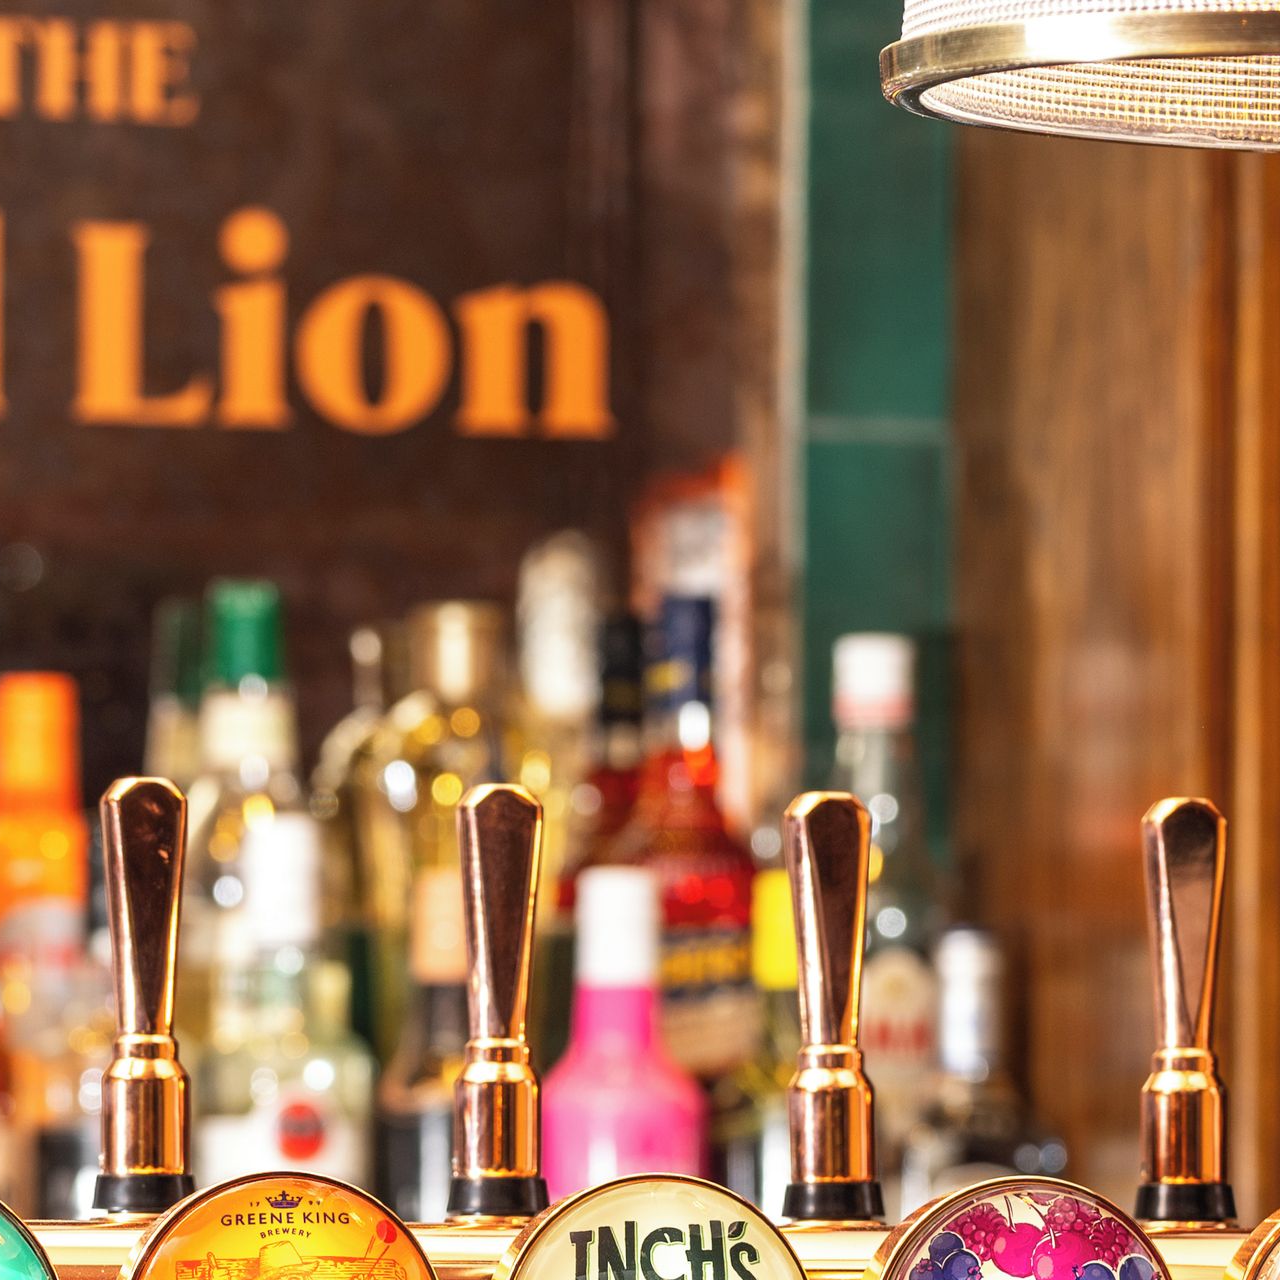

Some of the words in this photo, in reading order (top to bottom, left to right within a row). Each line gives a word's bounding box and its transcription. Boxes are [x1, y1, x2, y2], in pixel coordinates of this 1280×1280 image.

[71, 207, 613, 440] Lion
[220, 1212, 294, 1227] GREENE
[303, 1212, 350, 1225] KING
[260, 1228, 311, 1239] BREWERY
